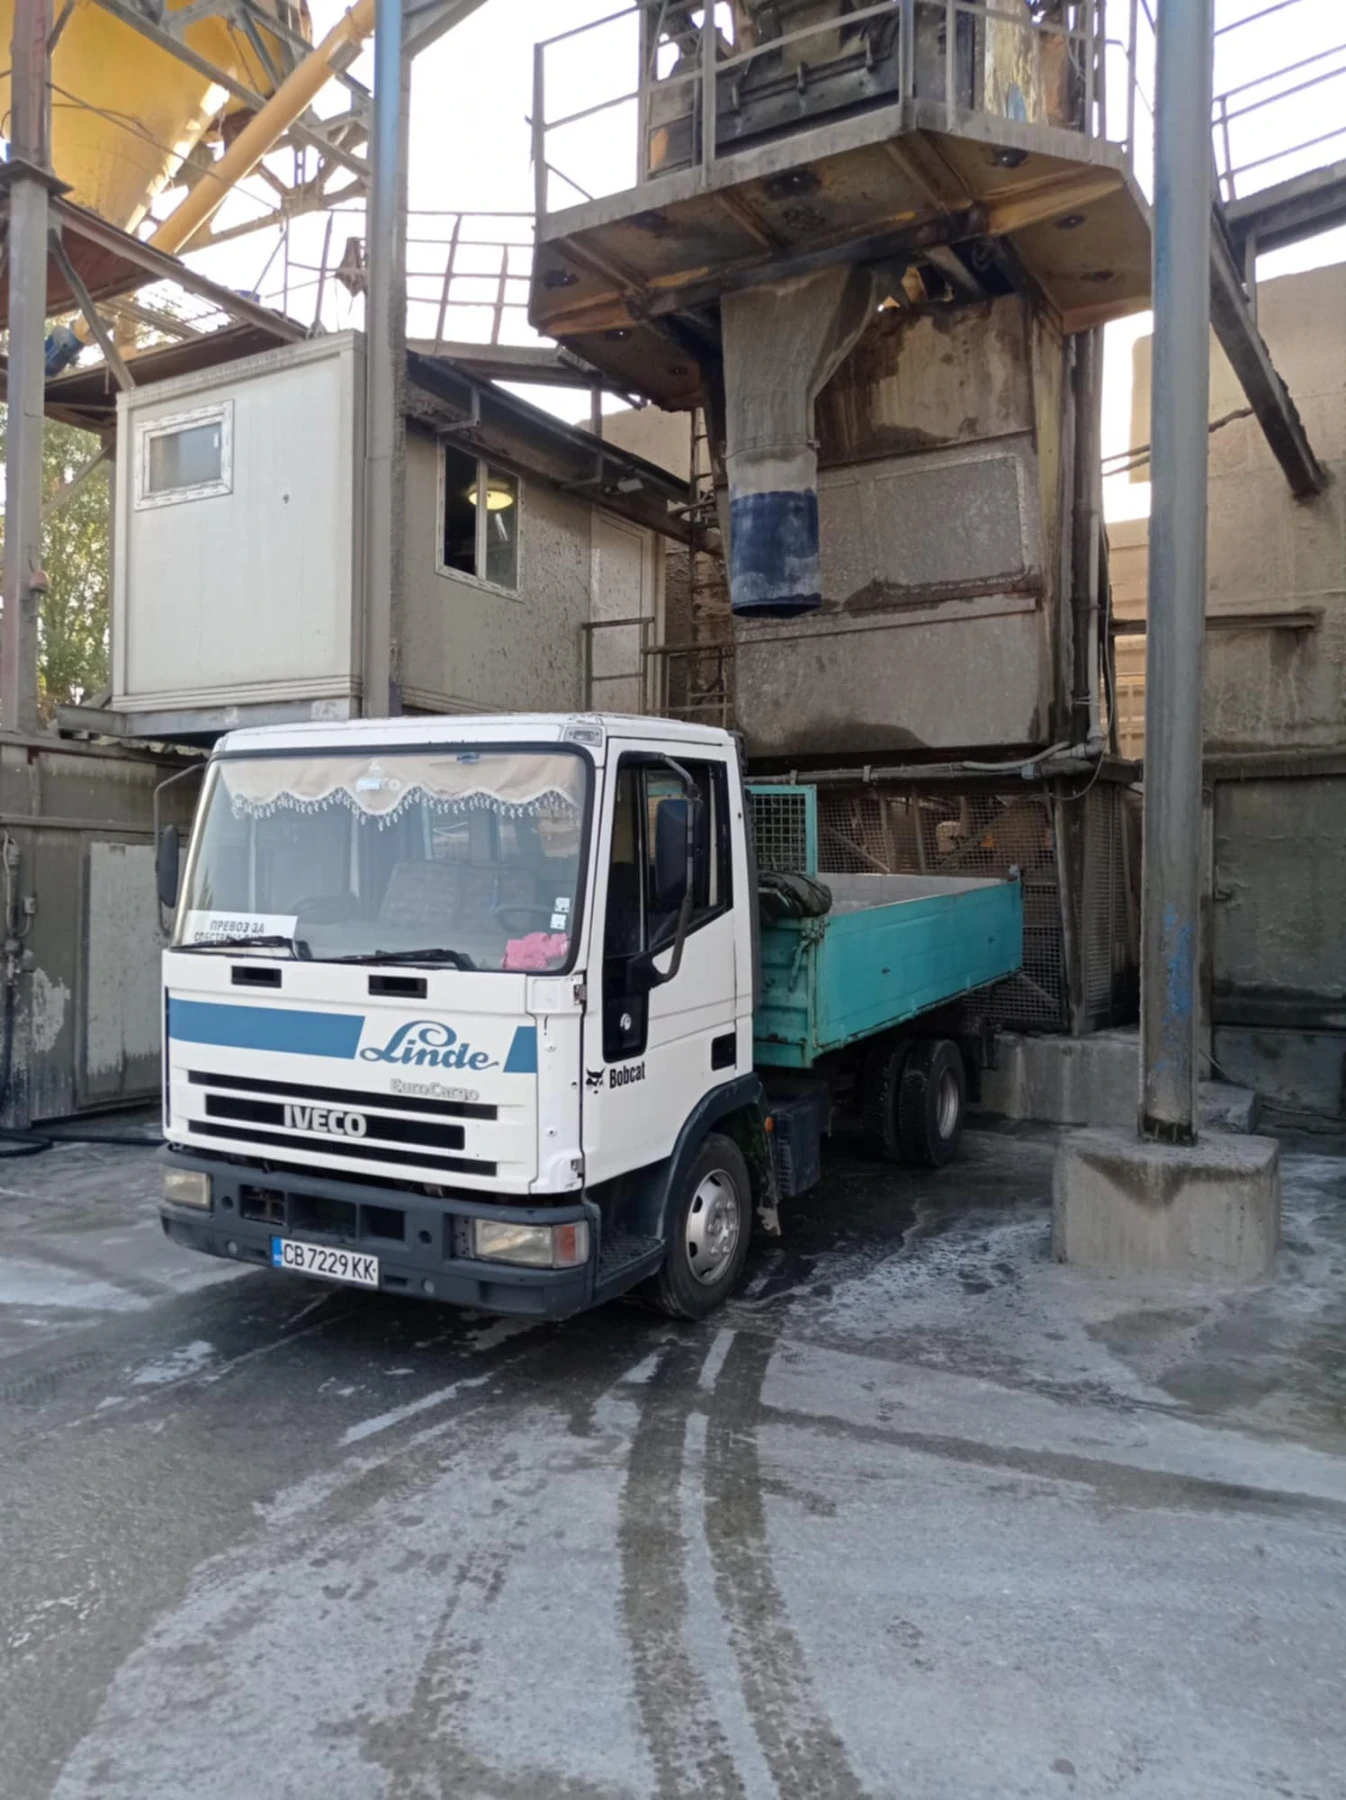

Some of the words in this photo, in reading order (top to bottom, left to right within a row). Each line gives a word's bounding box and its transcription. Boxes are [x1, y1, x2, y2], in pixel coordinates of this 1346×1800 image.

[210, 920, 250, 933] ПРЕВОЗ
[251, 922, 265, 934] ЗА
[360, 1019, 500, 1070] Linde
[609, 1061, 645, 1089] Bobcat
[390, 1078, 480, 1101] EuroCargo
[283, 1104, 367, 1138] IVECO
